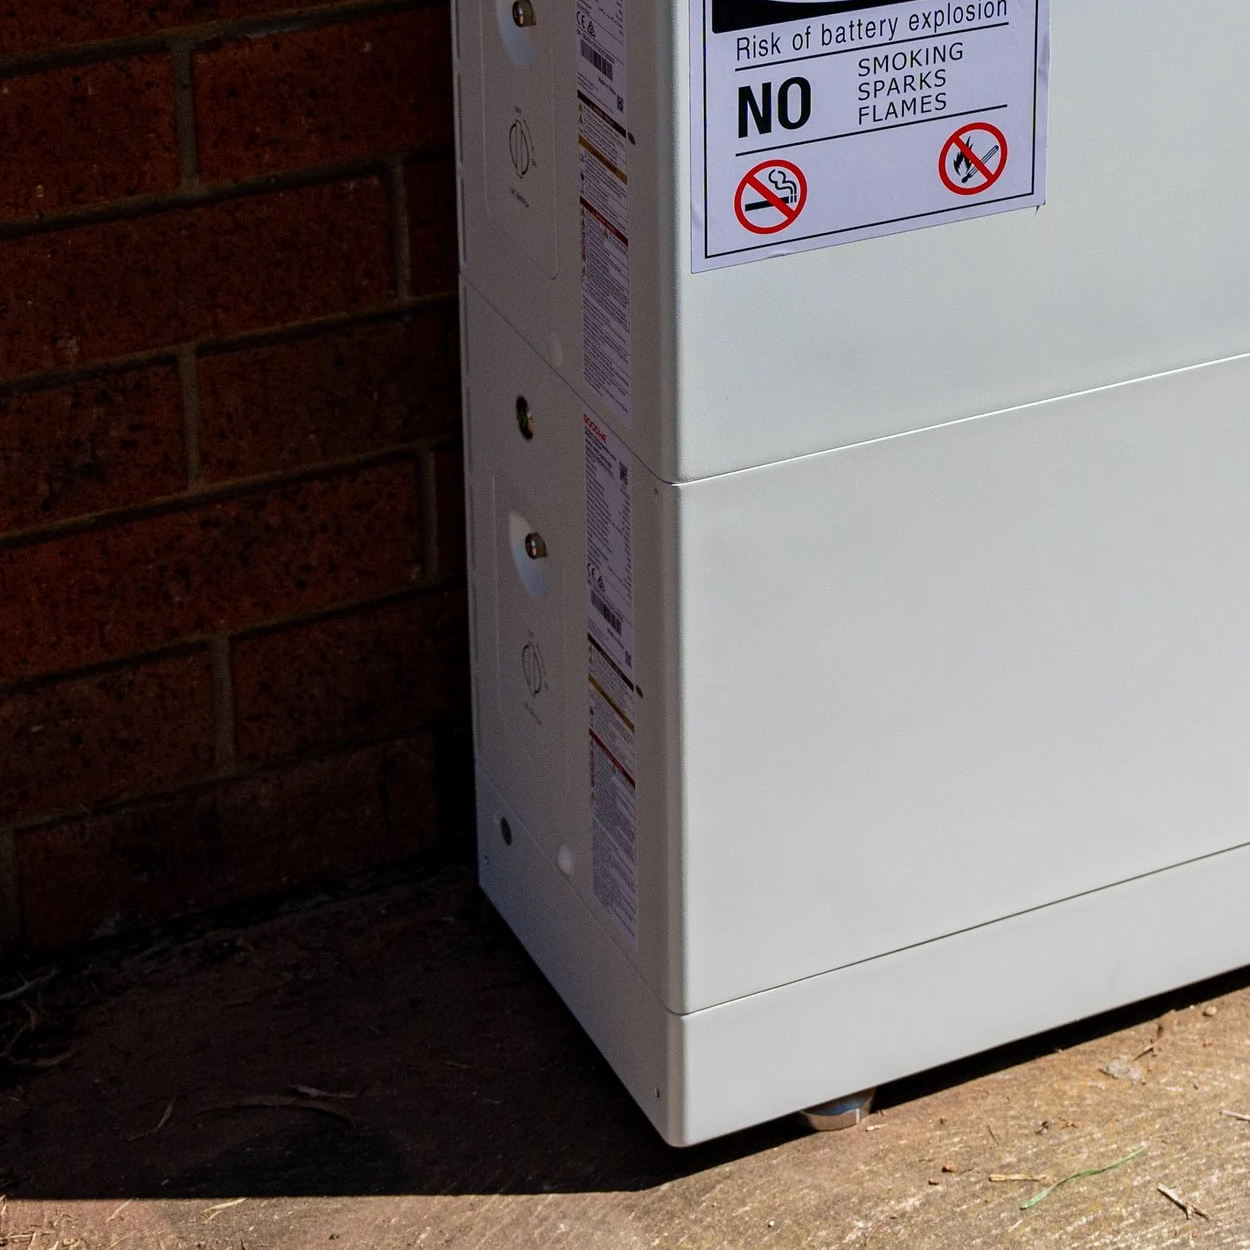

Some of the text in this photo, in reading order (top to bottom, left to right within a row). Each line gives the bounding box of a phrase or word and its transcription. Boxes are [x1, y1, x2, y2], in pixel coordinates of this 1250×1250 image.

[736, 36, 781, 62] Risk
[792, 26, 811, 51] of
[821, 15, 898, 47] battery
[858, 42, 964, 77] SMOKING
[858, 69, 947, 102] SPARKS
[738, 76, 811, 139] NO
[858, 92, 947, 126] FLAMES
